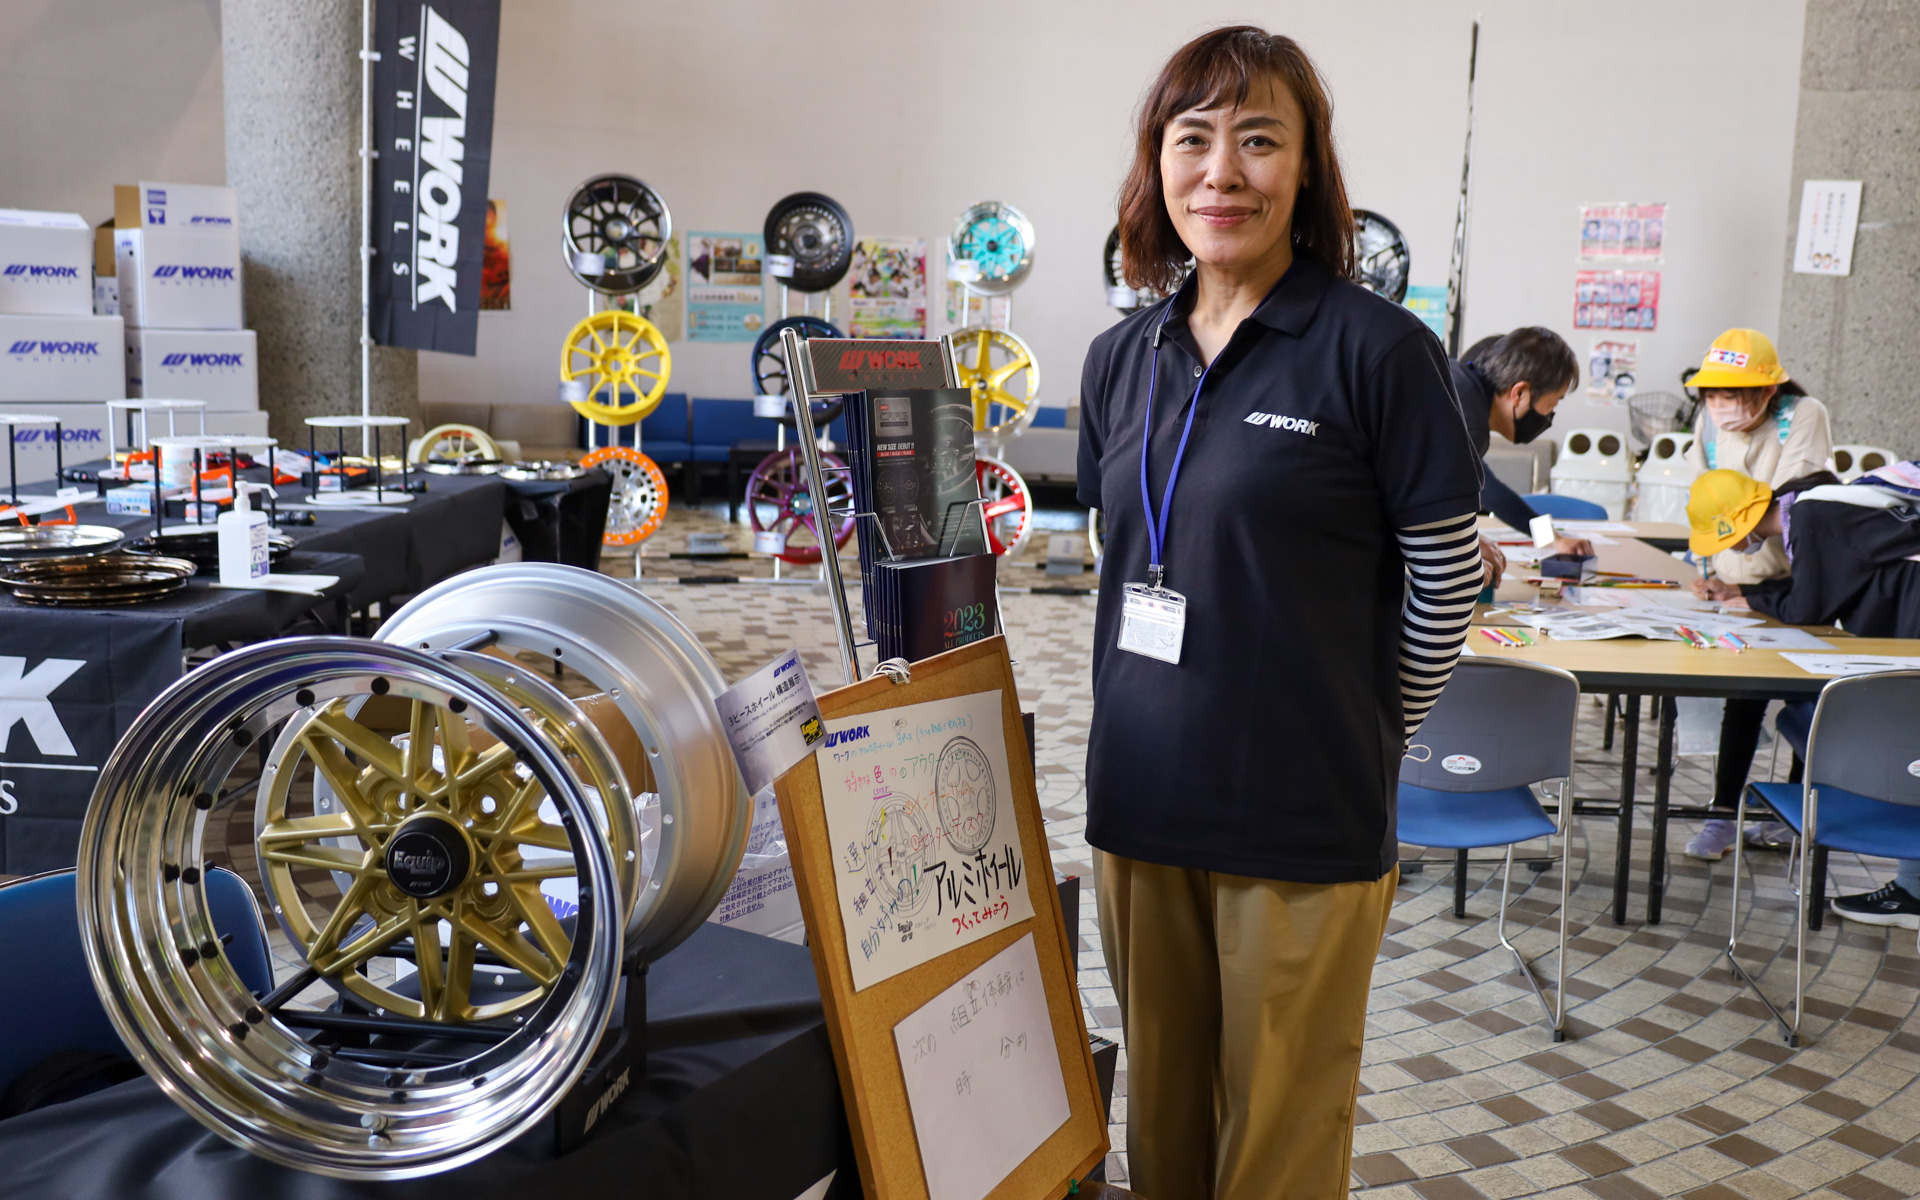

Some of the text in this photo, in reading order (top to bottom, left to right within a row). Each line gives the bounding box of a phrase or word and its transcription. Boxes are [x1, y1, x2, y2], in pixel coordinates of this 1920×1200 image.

[393, 35, 416, 277] WHEELS
[417, 115, 466, 314] WORK
[30, 265, 79, 279] WORK
[182, 265, 236, 280] WORK
[40, 341, 99, 356] WORK
[190, 353, 243, 367] WORK
[866, 350, 923, 370] WORK
[1268, 414, 1321, 437] WORK
[944, 602, 985, 638] 2023
[780, 657, 798, 673] WORK
[838, 725, 870, 744] WORK
[394, 849, 445, 875] Equip
[923, 844, 1022, 916] アルミホイール
[952, 895, 1010, 936] つくってみよう
[911, 1033, 937, 1064] 次の
[600, 1065, 630, 1116] WORK
[955, 1070, 972, 1096] 時
